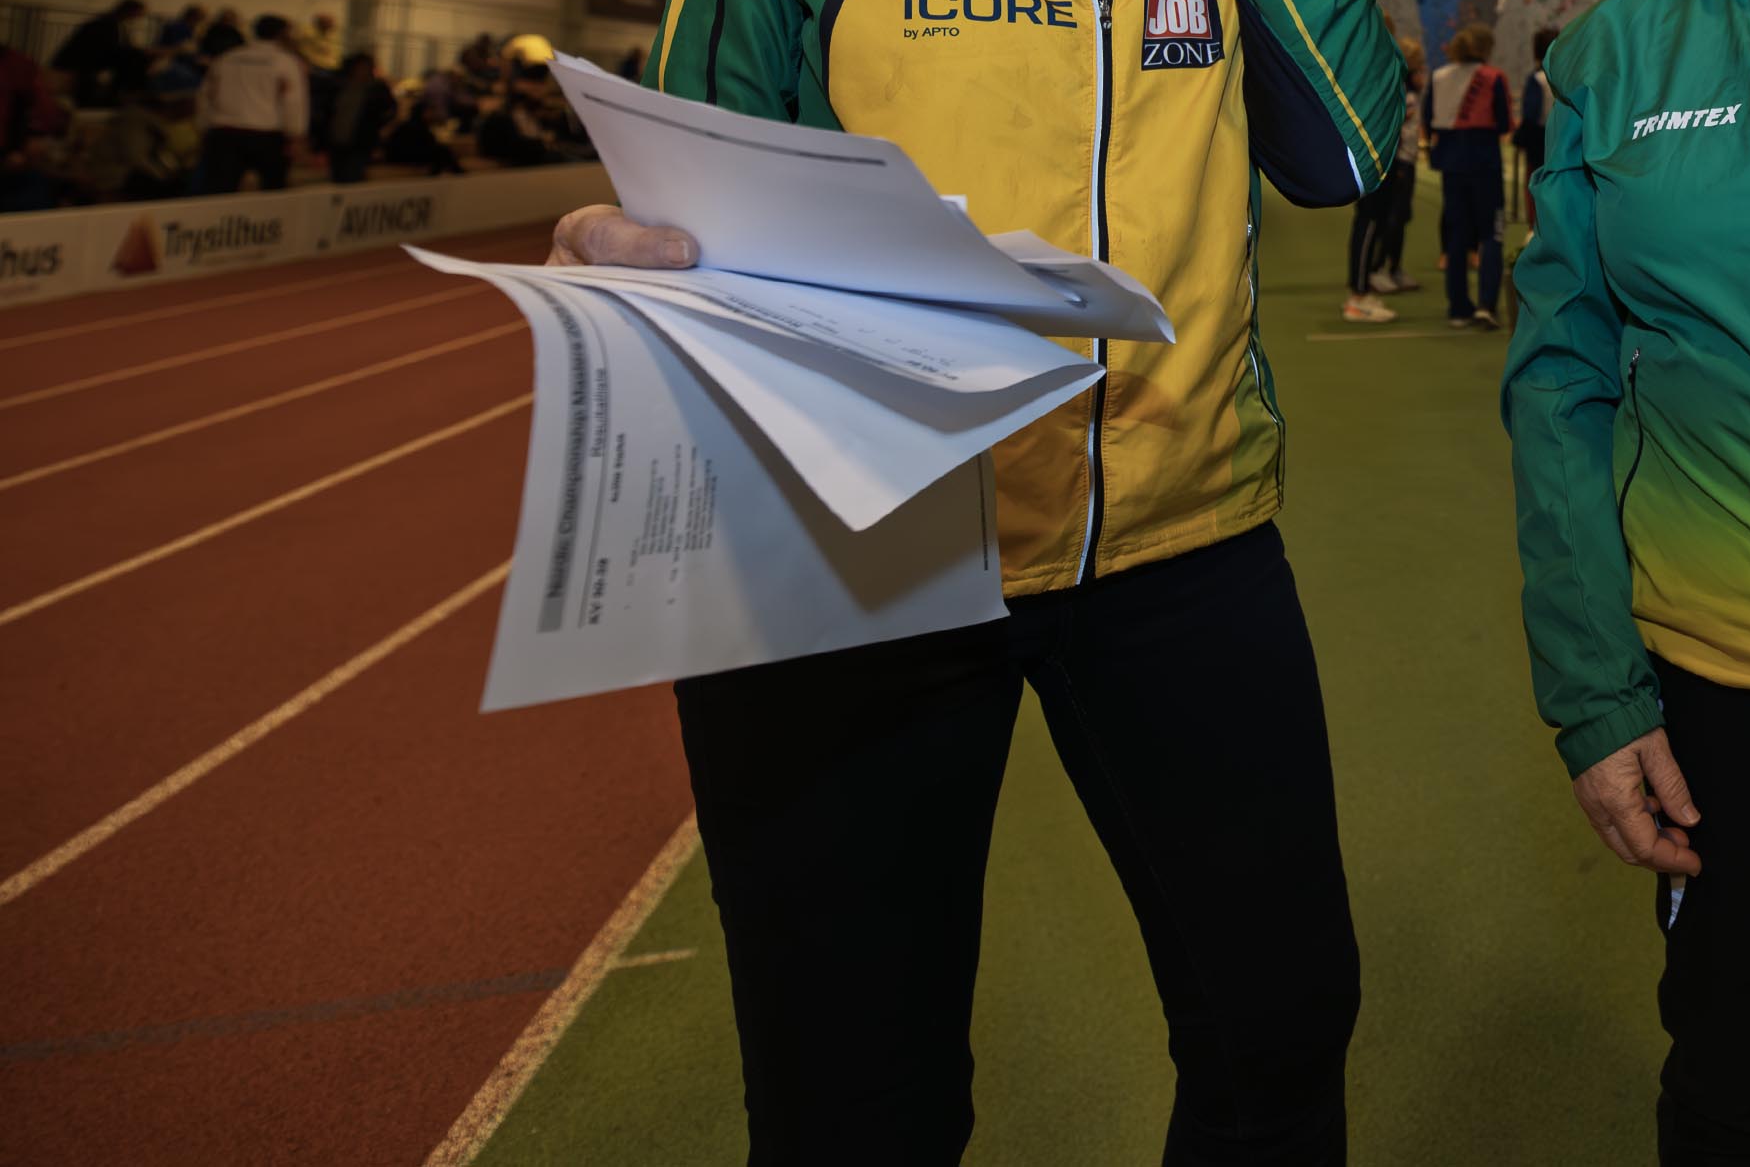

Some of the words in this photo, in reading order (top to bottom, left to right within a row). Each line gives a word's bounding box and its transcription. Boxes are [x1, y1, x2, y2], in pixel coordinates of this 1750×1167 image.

[904, 27, 919, 40] by
[922, 27, 960, 37] APTO
[1144, 40, 1224, 69] ZONE
[1632, 103, 1743, 141] TRIMTEX
[163, 216, 283, 264] Trysilhus
